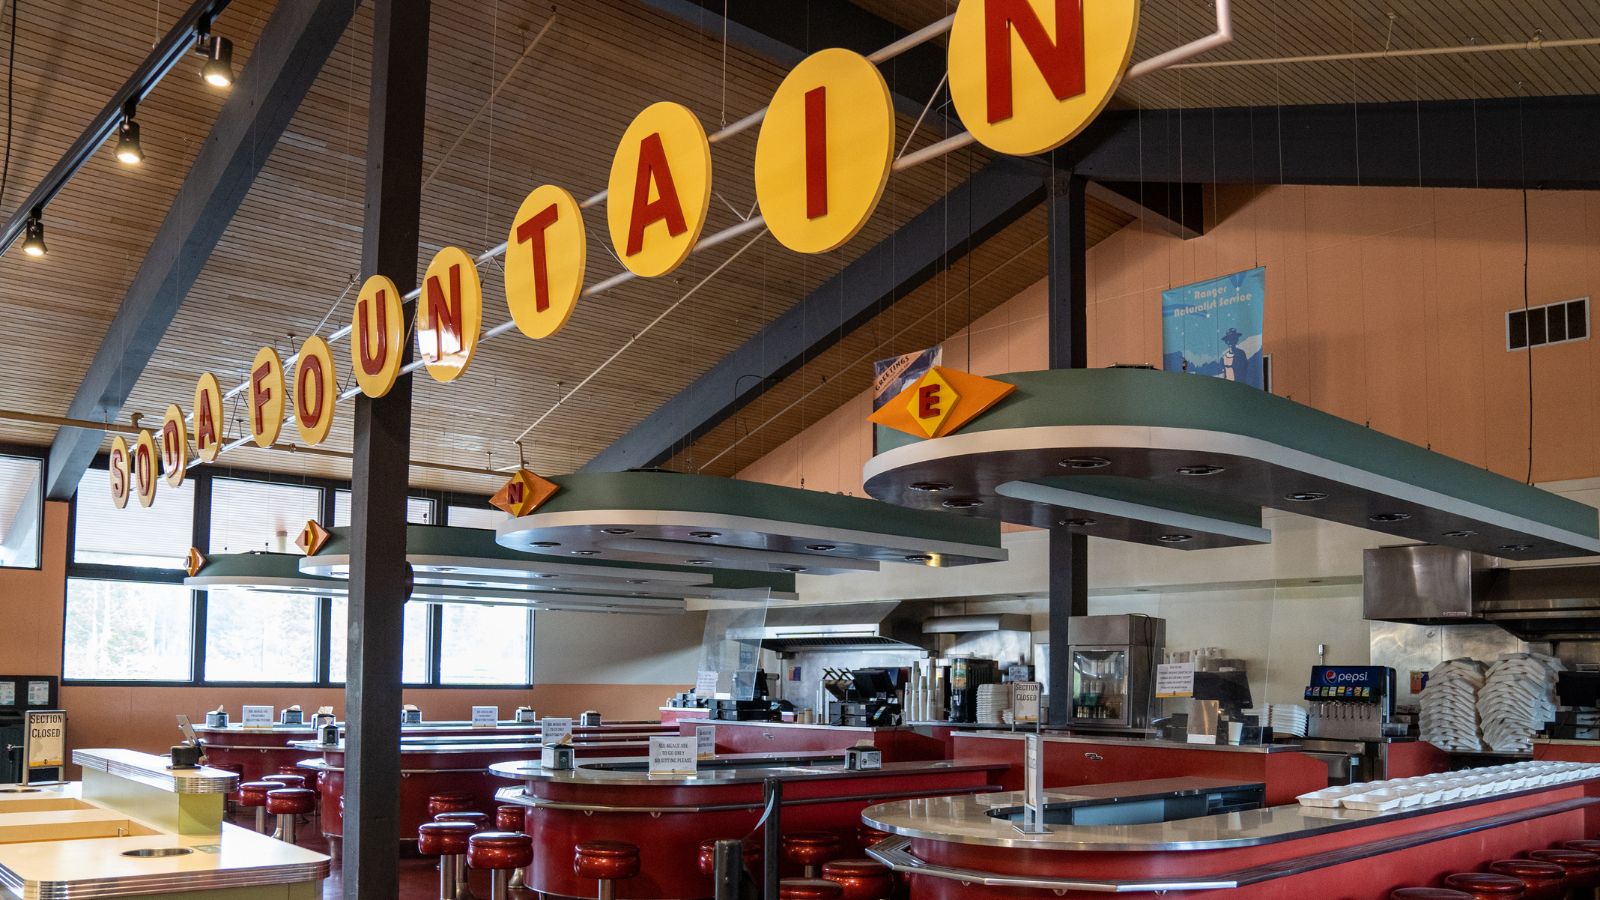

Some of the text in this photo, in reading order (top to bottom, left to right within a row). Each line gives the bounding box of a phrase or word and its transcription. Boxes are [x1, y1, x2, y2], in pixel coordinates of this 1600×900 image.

[111, 0, 1086, 499] SODA FOUNTAIN
[1193, 285, 1228, 300] Ranger
[1173, 292, 1253, 318] Naturalist Service
[875, 355, 910, 391] GREETINGS
[918, 383, 941, 420] E
[507, 481, 524, 505] N
[1337, 671, 1368, 683] pepsi
[1015, 684, 1039, 692] SECTION
[1016, 693, 1037, 702] CLOSED
[30, 714, 62, 724] SECTION
[31, 728, 61, 738] CLOSED
